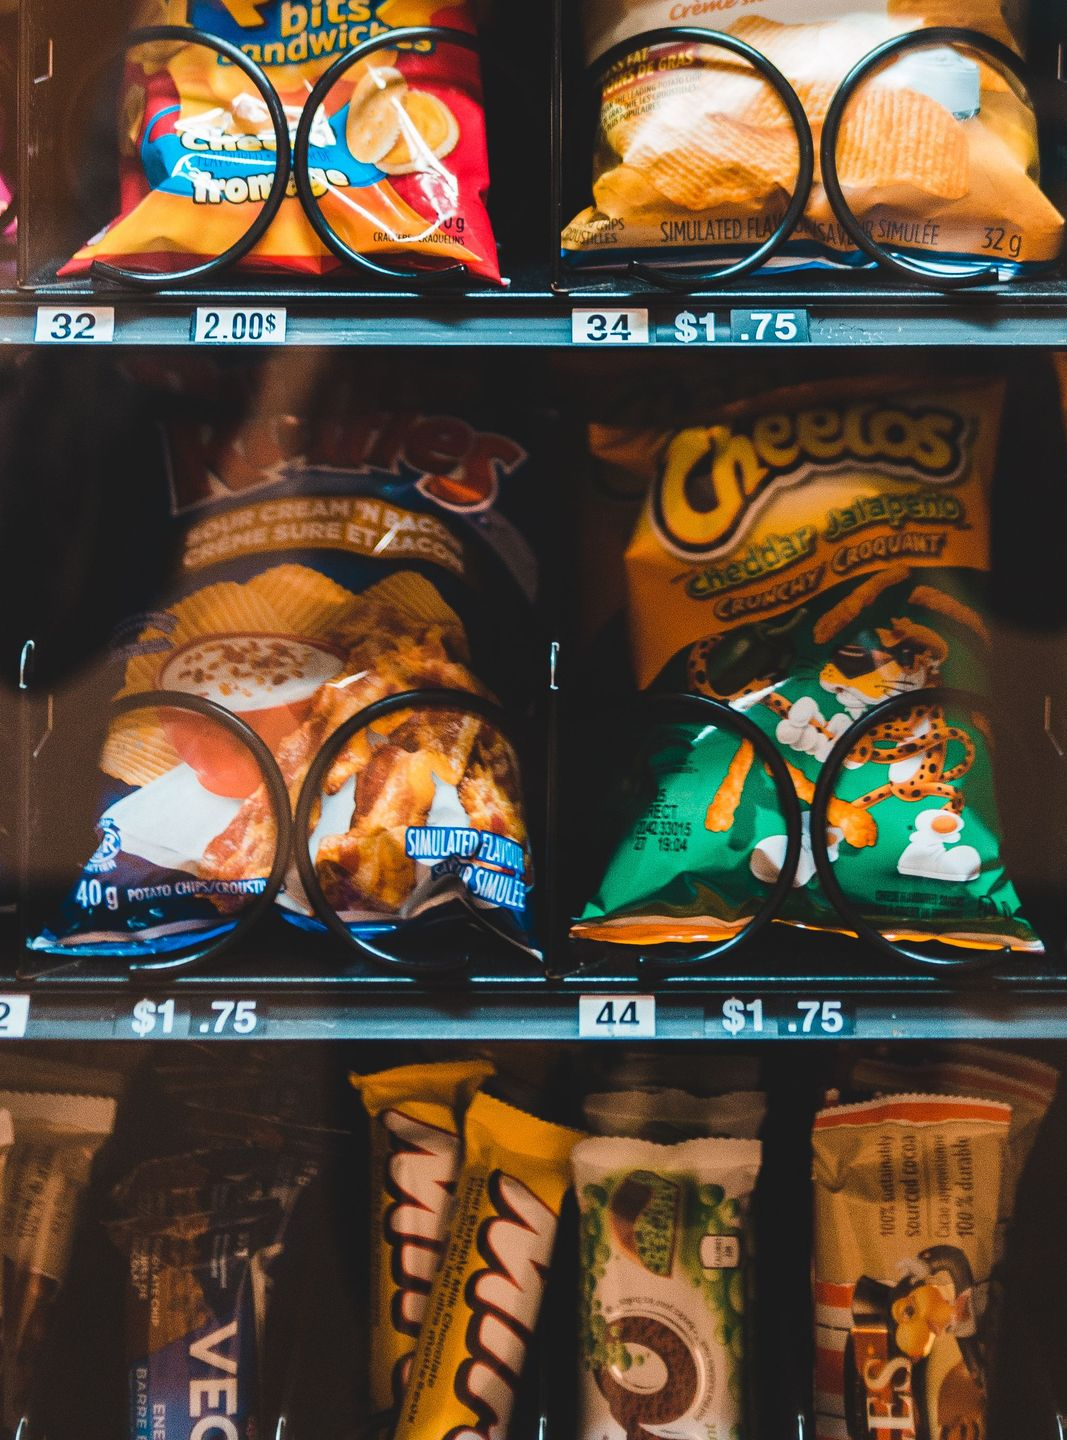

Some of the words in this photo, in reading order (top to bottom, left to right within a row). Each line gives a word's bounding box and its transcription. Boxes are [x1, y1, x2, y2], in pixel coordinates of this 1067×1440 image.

[657, 49, 695, 72] GRAS
[659, 218, 742, 243] SIMULATED
[877, 218, 941, 246] SIMULÉE
[980, 226, 1005, 250] 32
[1008, 233, 1023, 258] g
[50, 312, 97, 340] 32
[203, 312, 277, 340] 2.00$
[585, 313, 632, 341] 34
[673, 310, 717, 343] $1
[740, 312, 798, 341] .75
[272, 520, 343, 543] SURE
[346, 524, 377, 548] ET
[407, 828, 480, 857] SIMULATED
[75, 878, 103, 909] 40
[104, 884, 120, 911] g
[126, 882, 172, 903] POTATO
[131, 998, 176, 1036] $1
[199, 1001, 257, 1033] .75
[594, 1001, 640, 1026] 44
[721, 997, 763, 1035] $1
[787, 1001, 844, 1033] .75
[955, 1211, 975, 1237] 100
[135, 1366, 149, 1429] BARRE
